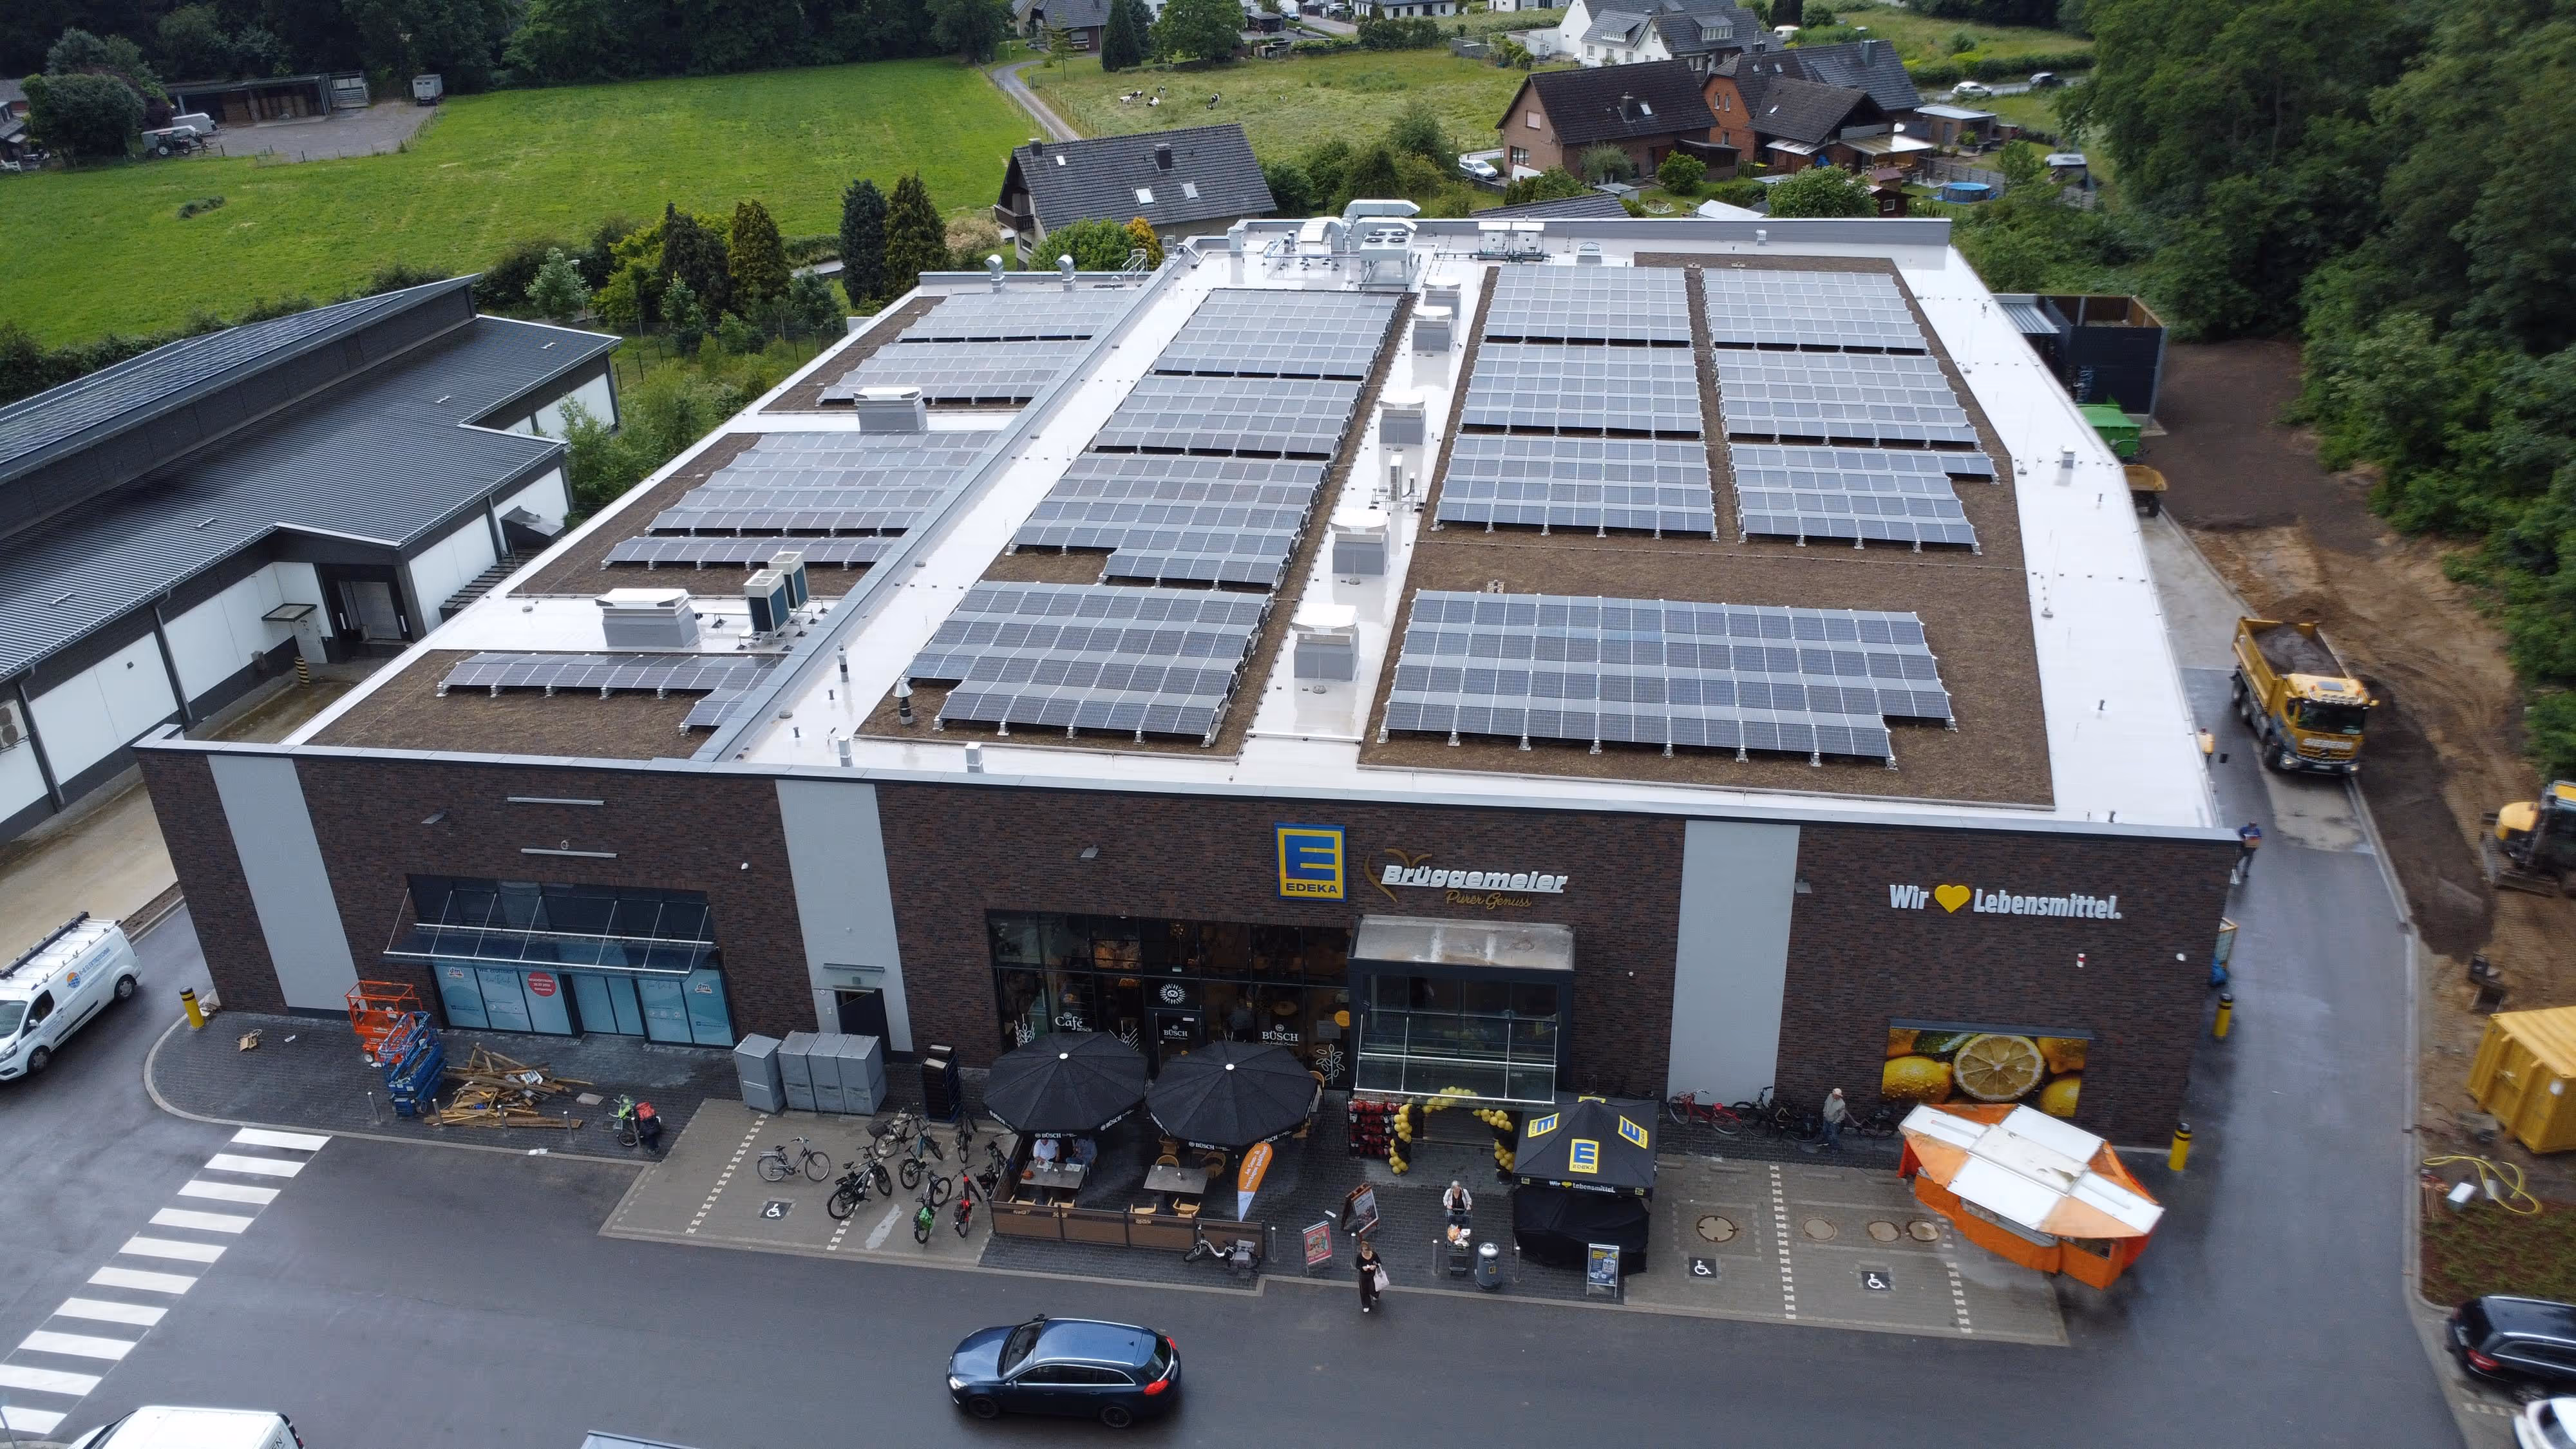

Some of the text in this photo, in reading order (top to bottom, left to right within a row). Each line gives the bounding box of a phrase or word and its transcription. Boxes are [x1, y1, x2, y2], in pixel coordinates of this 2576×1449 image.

[1381, 865, 1568, 893] Brüggemeier
[1285, 883, 1338, 894] EDEKA
[1445, 889, 1532, 910] Purer Genuss
[1889, 885, 2122, 920] Wir Lebensmittel.
[1055, 1016, 1083, 1030] Café
[1262, 1030, 1299, 1041] BÜSCH
